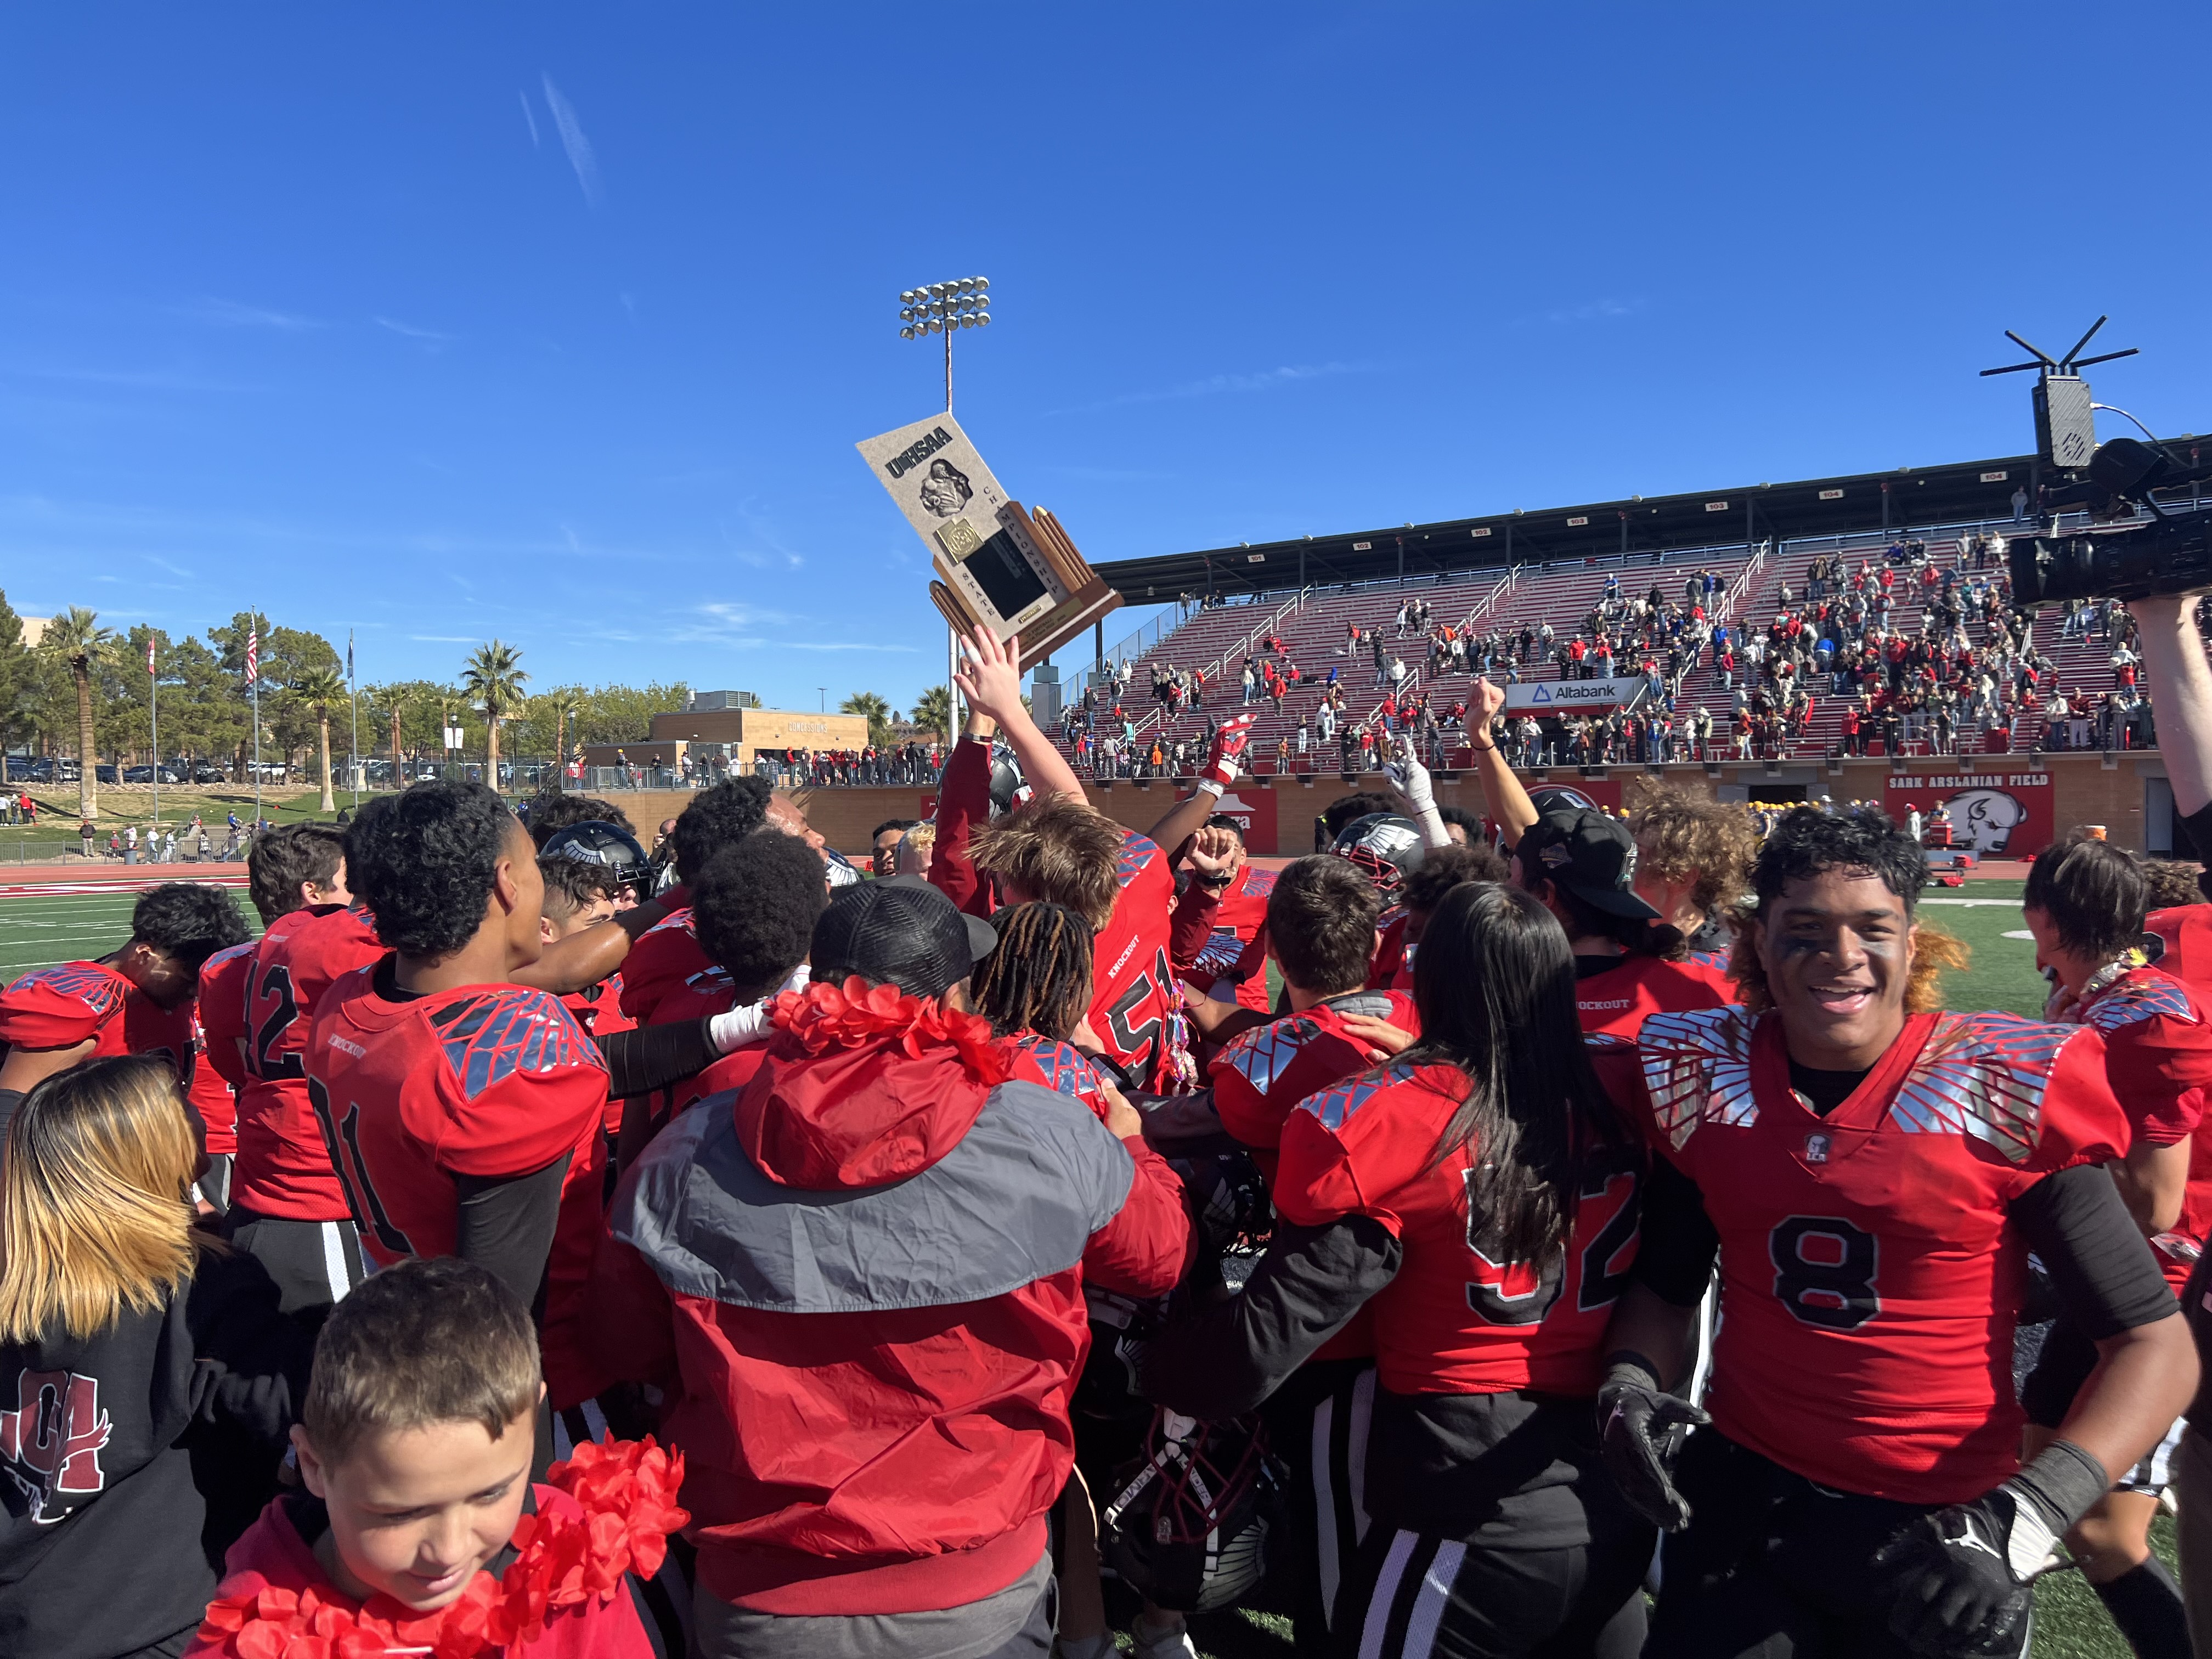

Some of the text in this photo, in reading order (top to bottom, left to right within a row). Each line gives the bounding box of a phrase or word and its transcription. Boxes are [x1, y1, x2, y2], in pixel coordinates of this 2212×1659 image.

[983, 486, 1058, 594] CHAMPIONSHIP
[962, 573, 995, 616] STATE
[1555, 684, 1616, 698] Altabank
[788, 721, 827, 733] CONCESSIONS
[1889, 774, 2049, 788] SARK ARSLANIAN FIELD
[1108, 934, 1140, 979] KNOCKOUT
[243, 958, 306, 1081] 12
[1576, 999, 1630, 1010] OCKOUT
[308, 1073, 415, 1256] 11
[1768, 1214, 1881, 1332] 8
